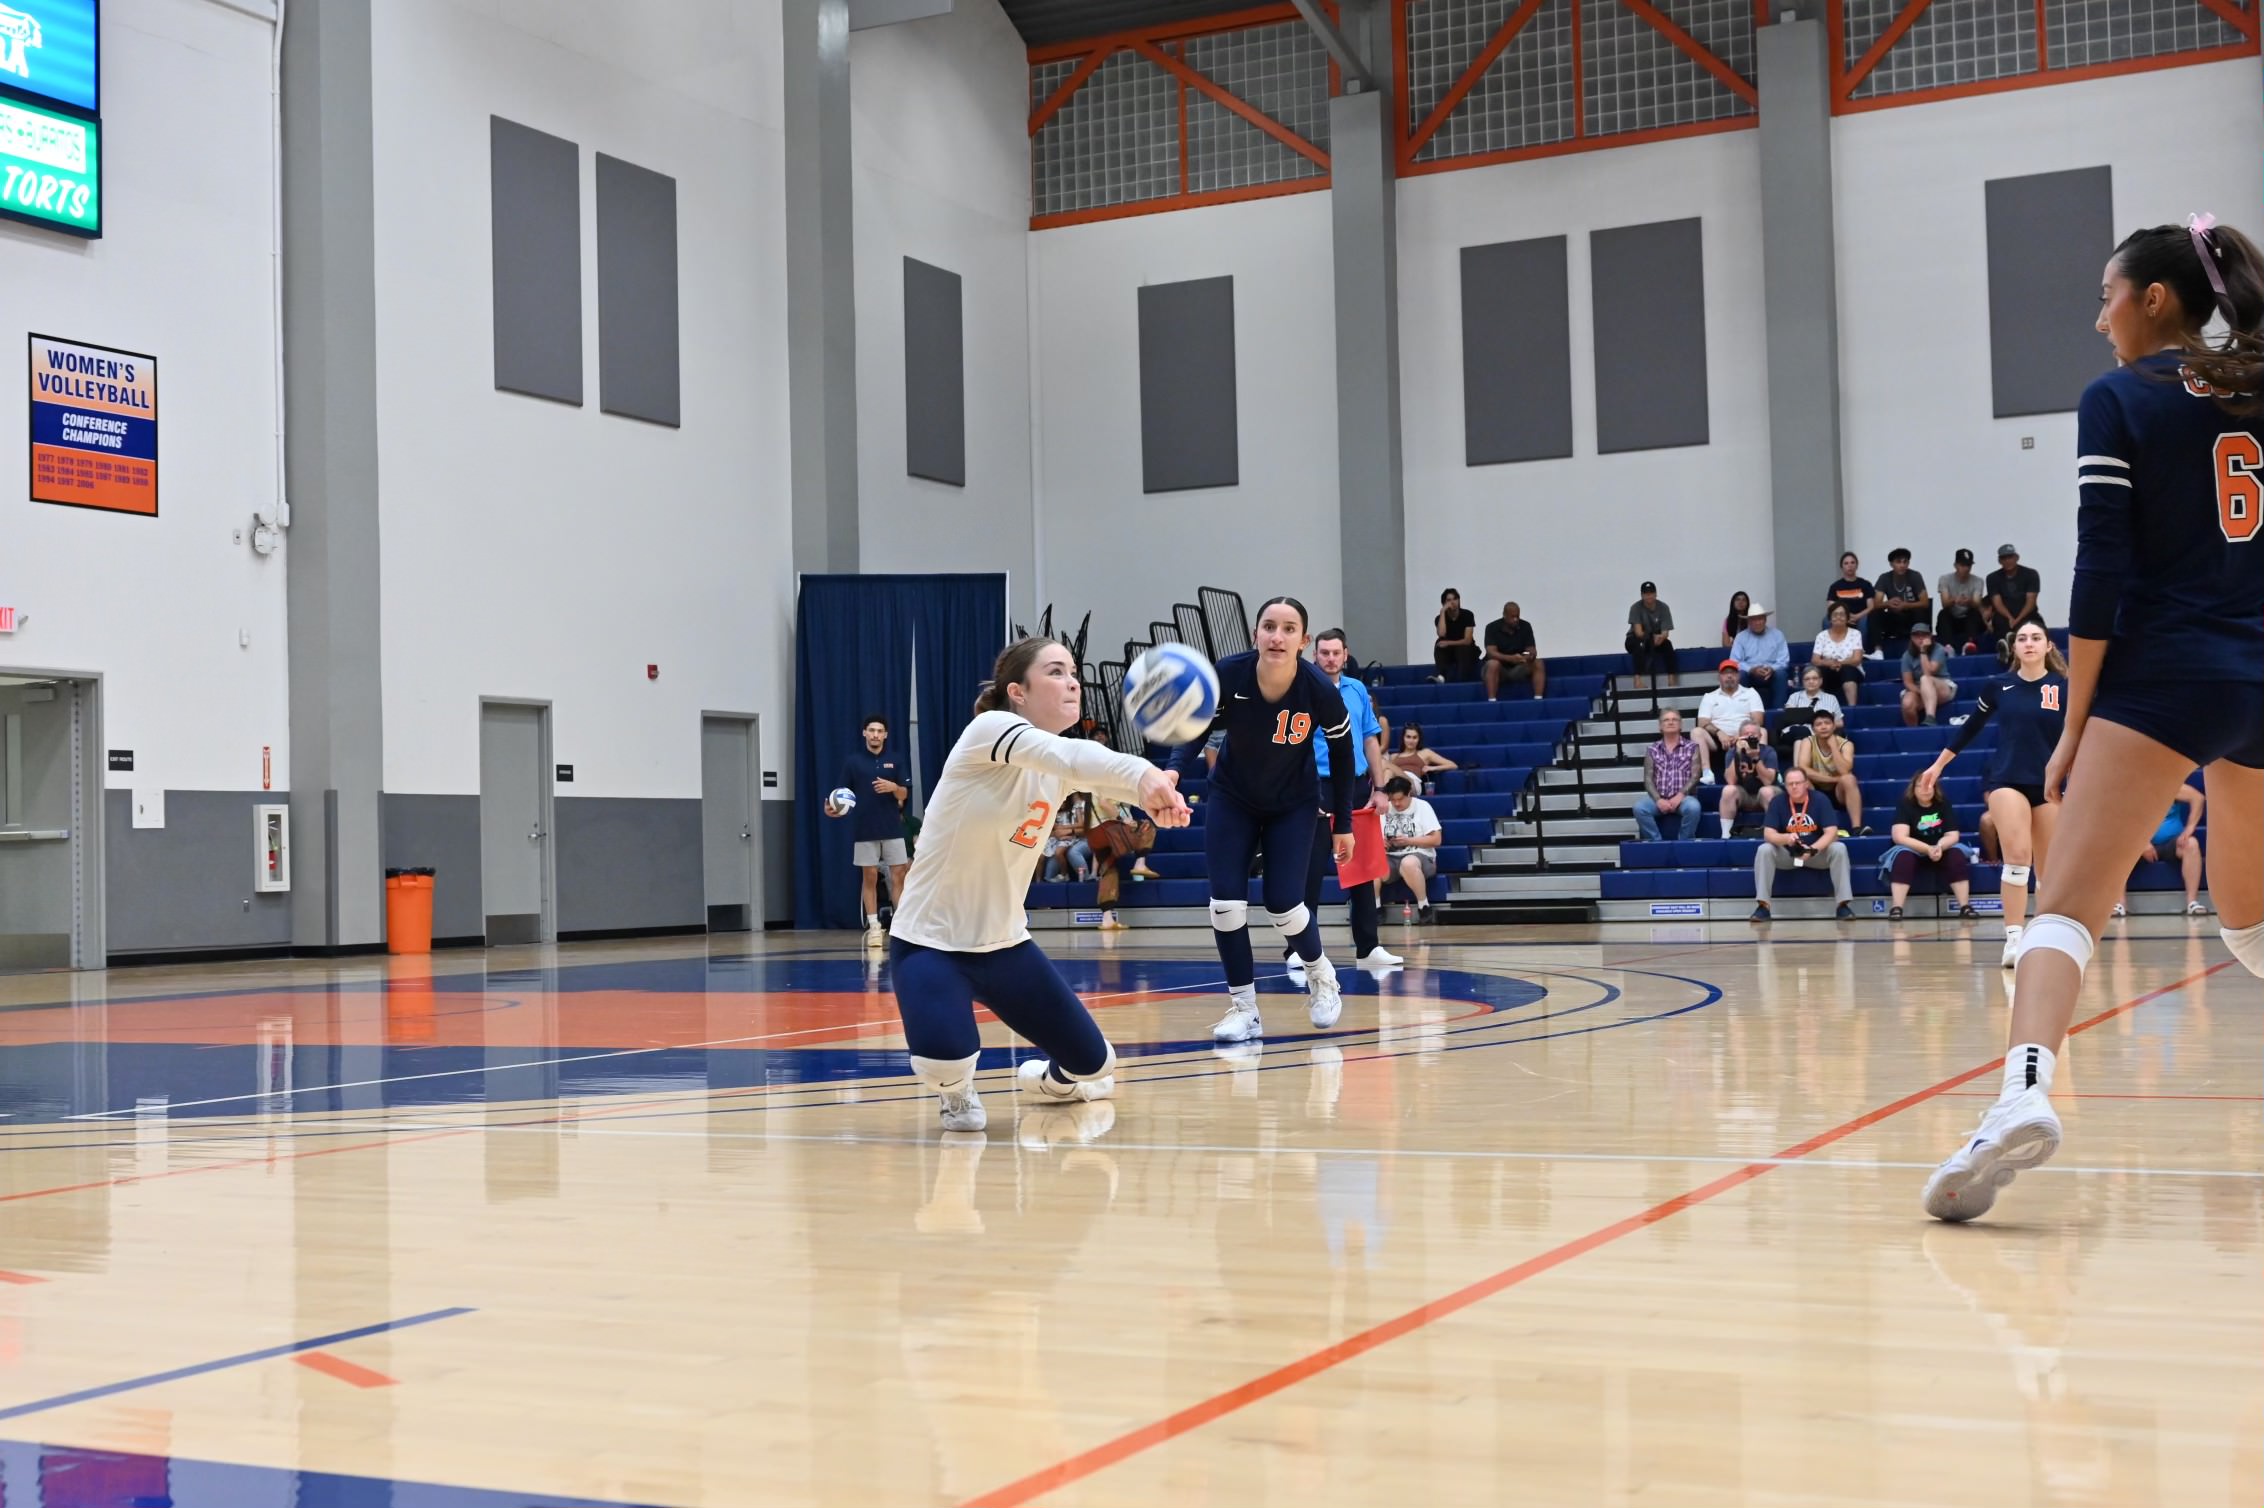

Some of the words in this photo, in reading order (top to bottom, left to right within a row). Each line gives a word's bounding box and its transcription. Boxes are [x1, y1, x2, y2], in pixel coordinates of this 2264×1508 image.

[47, 349, 135, 383] WOMEN'S
[38, 372, 150, 409] VOLLEYBALL
[62, 412, 128, 435] CONFERENCE
[62, 427, 123, 449] CHAMPIONS
[2212, 431, 2264, 543] 6
[2040, 684, 2060, 711] 11
[1272, 709, 1312, 744] 19
[1008, 799, 1050, 849] 2
